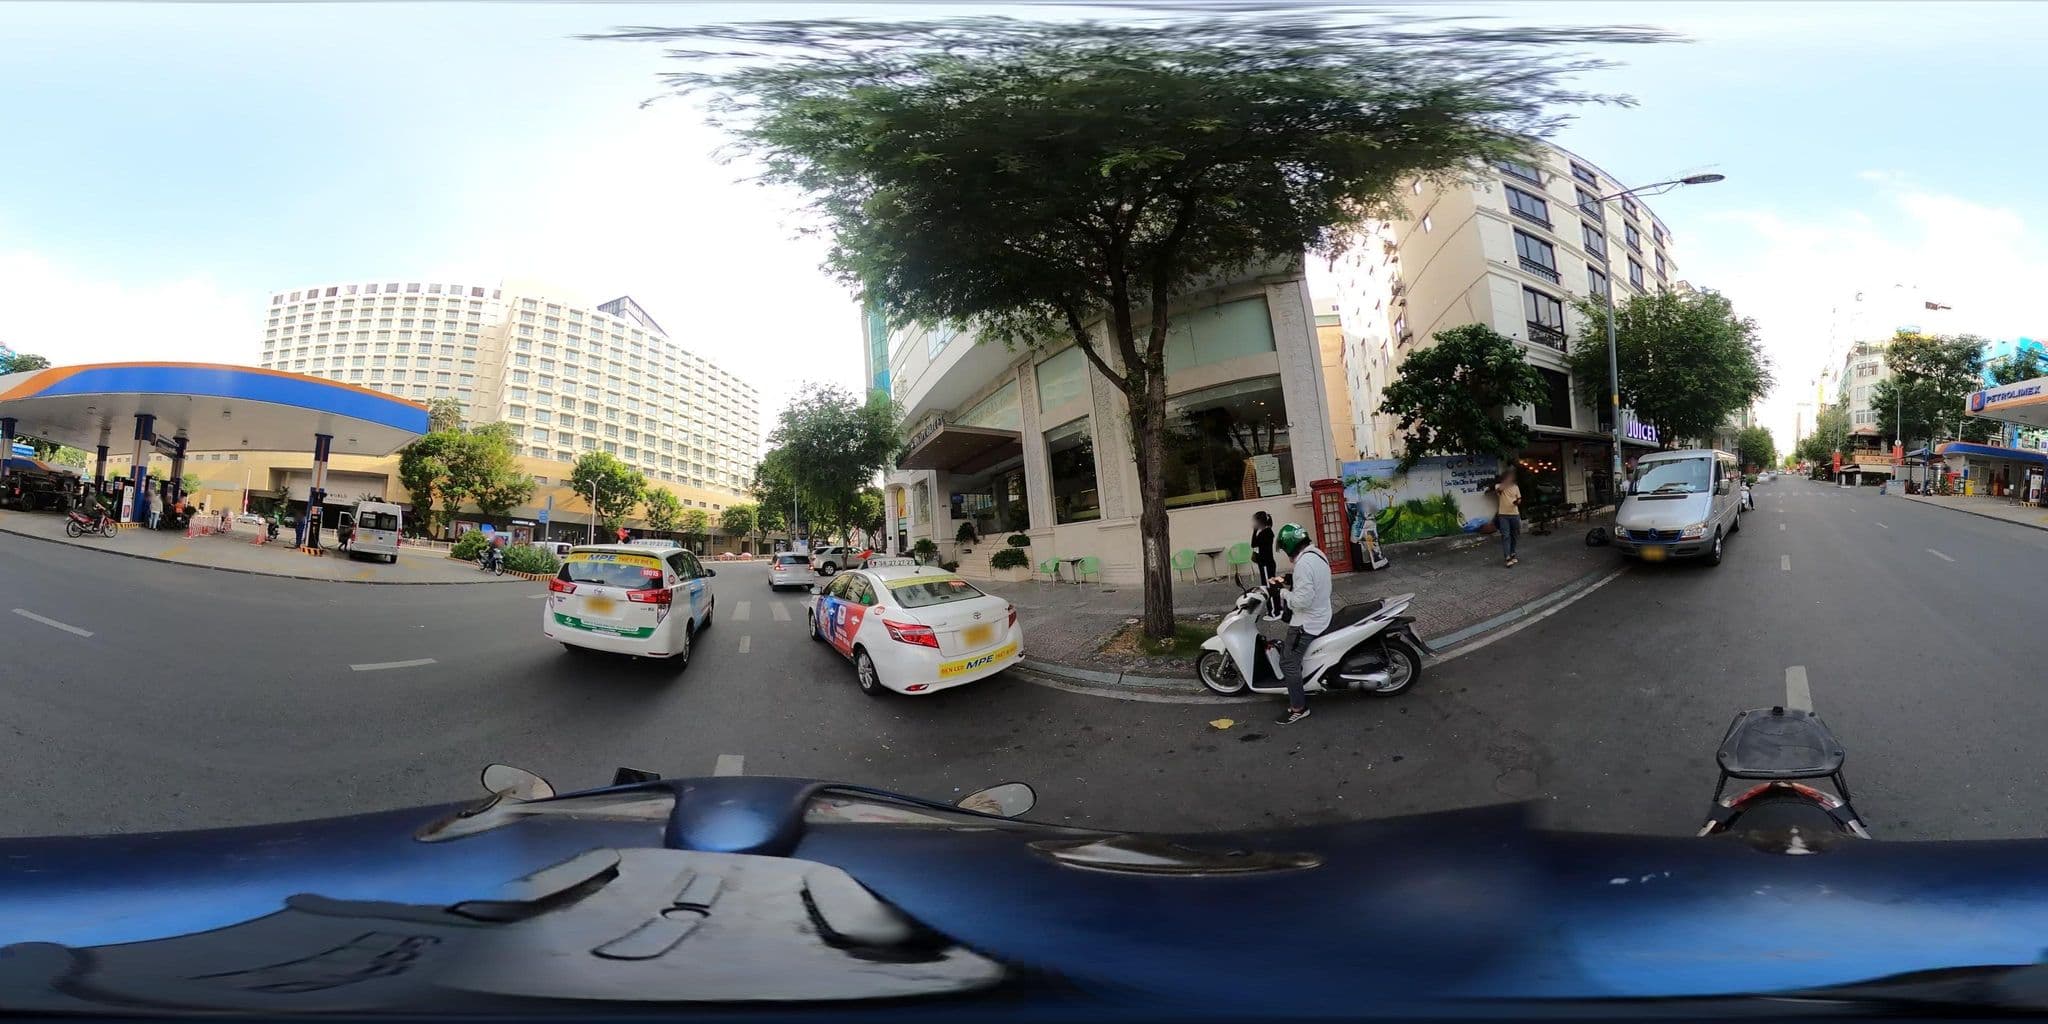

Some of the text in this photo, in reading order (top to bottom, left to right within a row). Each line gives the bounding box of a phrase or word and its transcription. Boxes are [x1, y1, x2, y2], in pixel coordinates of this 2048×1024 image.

[1986, 385, 2041, 403] PETROLIMEX
[589, 553, 616, 561] MPE
[966, 654, 994, 670] MPE
